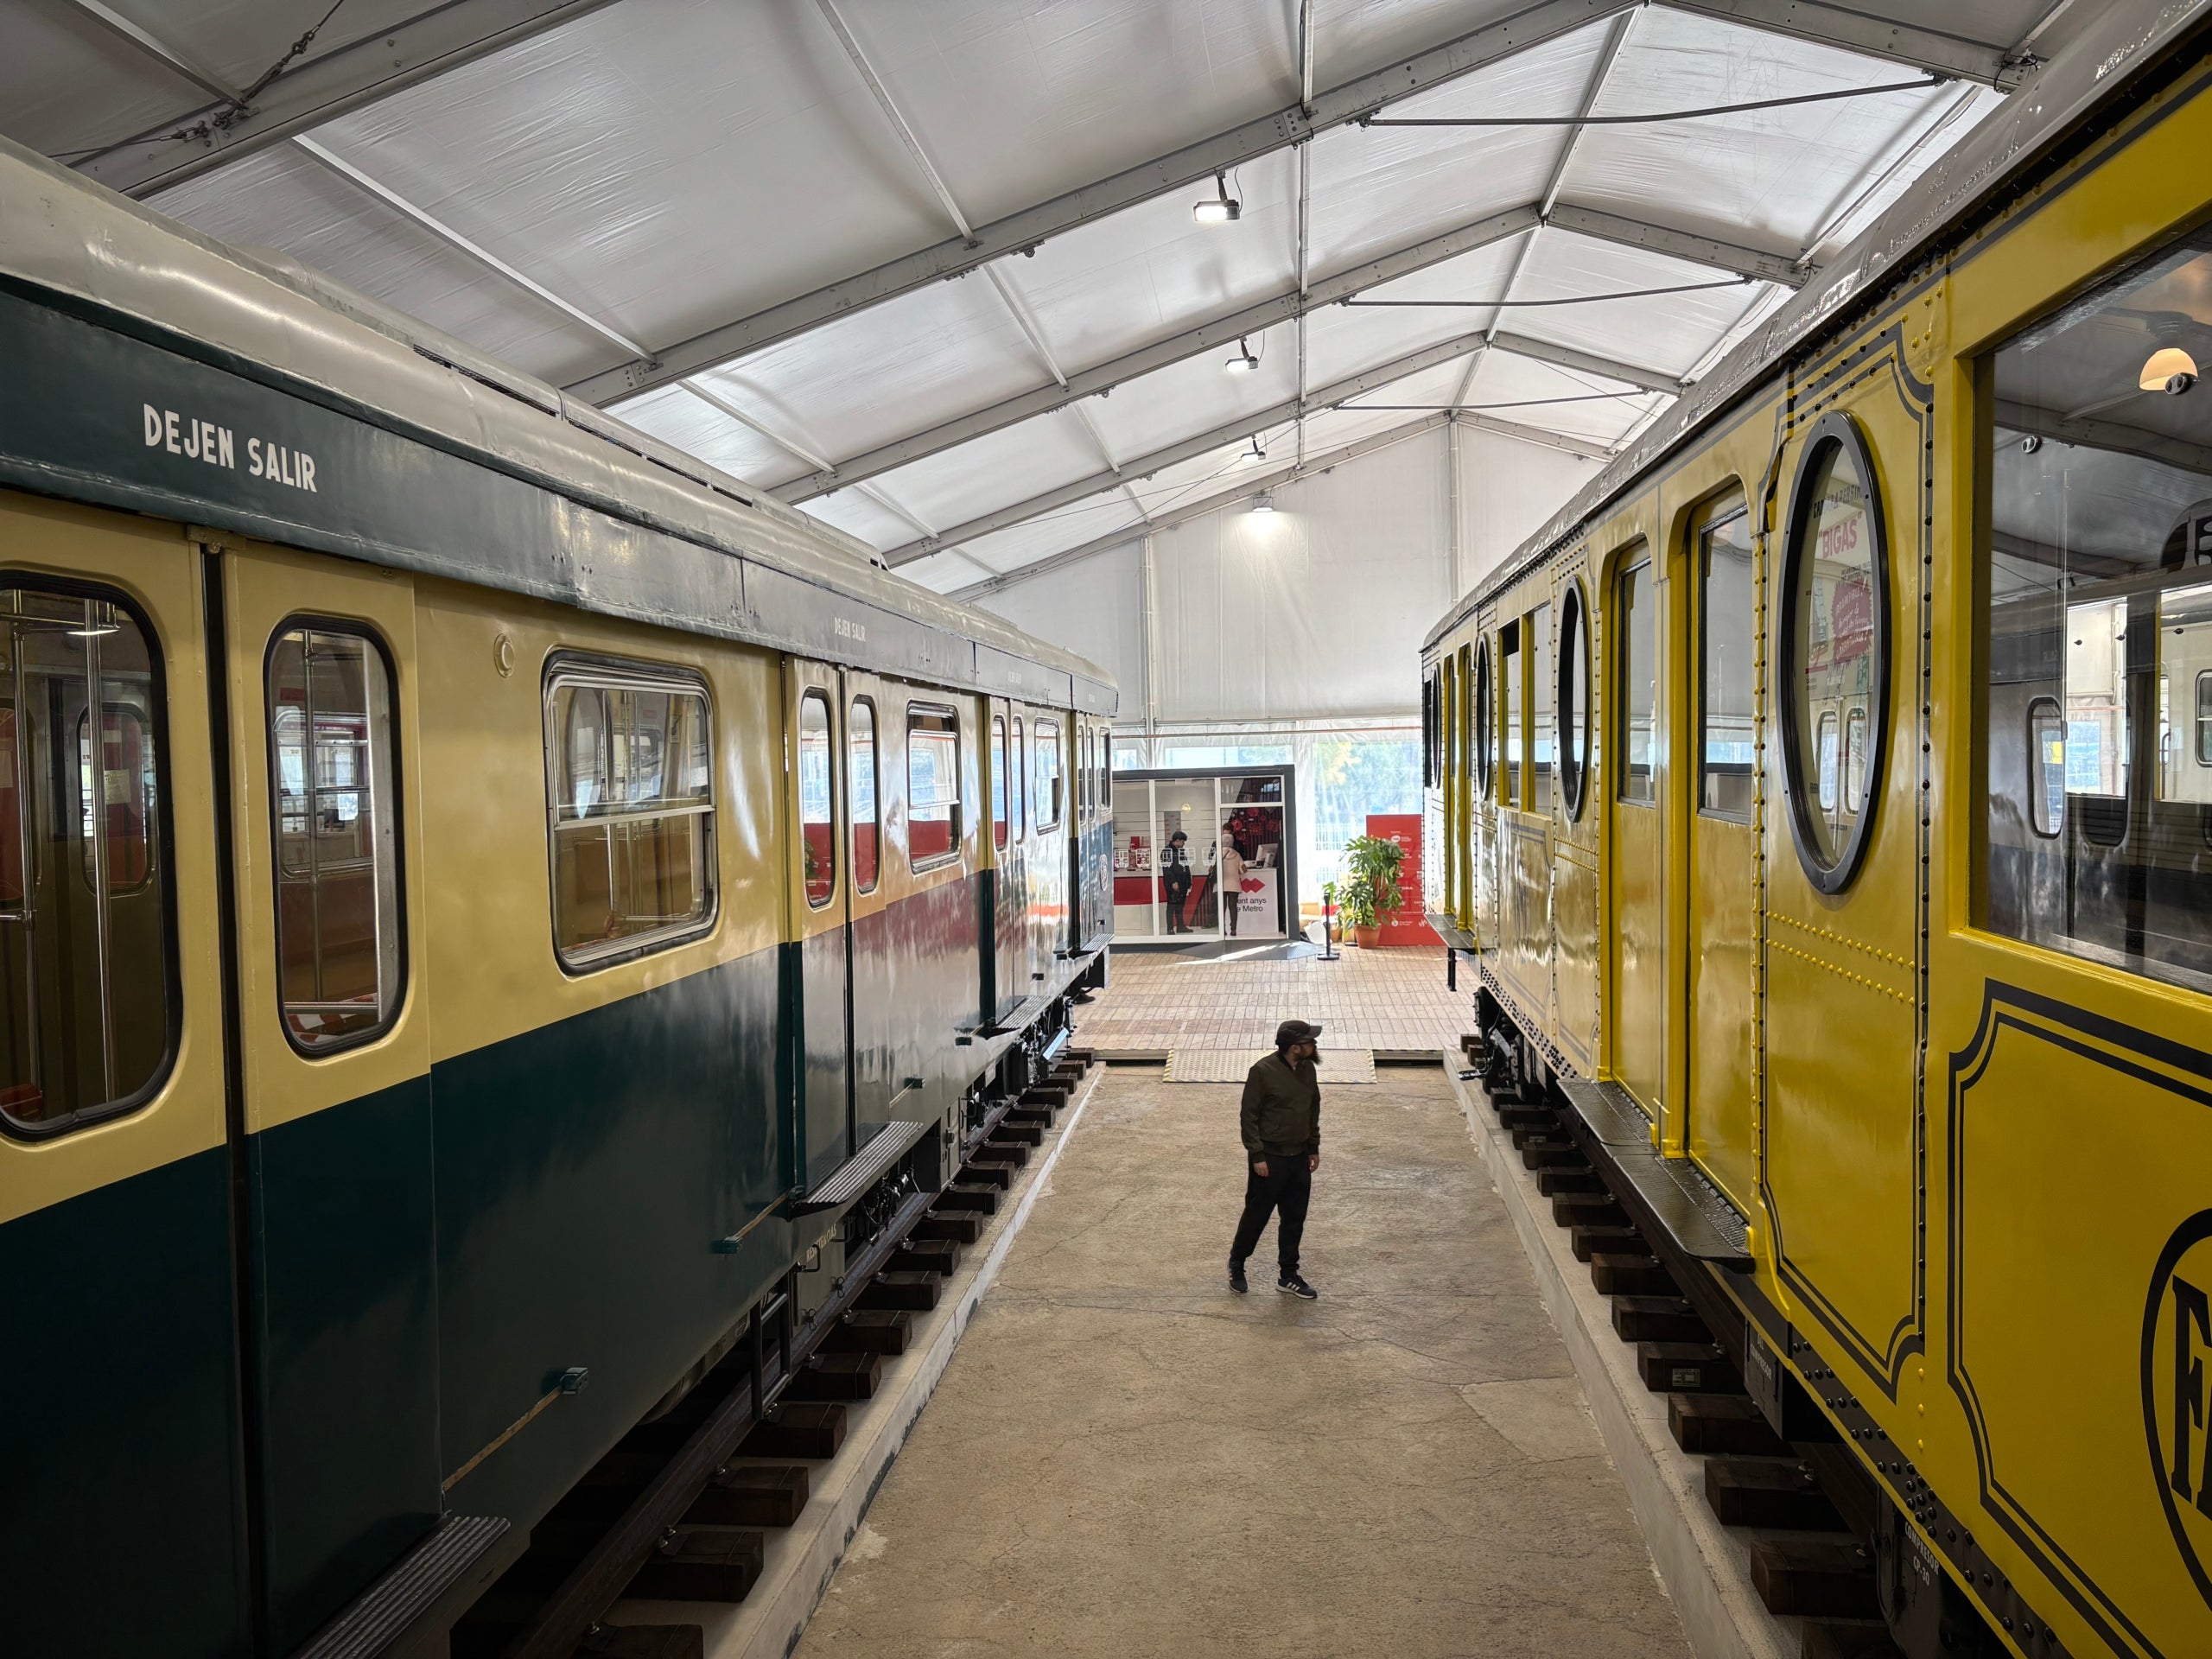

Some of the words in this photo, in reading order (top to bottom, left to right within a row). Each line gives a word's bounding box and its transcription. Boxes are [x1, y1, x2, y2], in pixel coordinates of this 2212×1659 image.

[143, 403, 235, 469] DEJEN
[247, 437, 318, 493] SALIR
[834, 616, 851, 638] DEJEN
[852, 622, 866, 642] SALIR
[1904, 1521, 1940, 1576] COMPRESOR
[1913, 1554, 1930, 1586] CP-30
